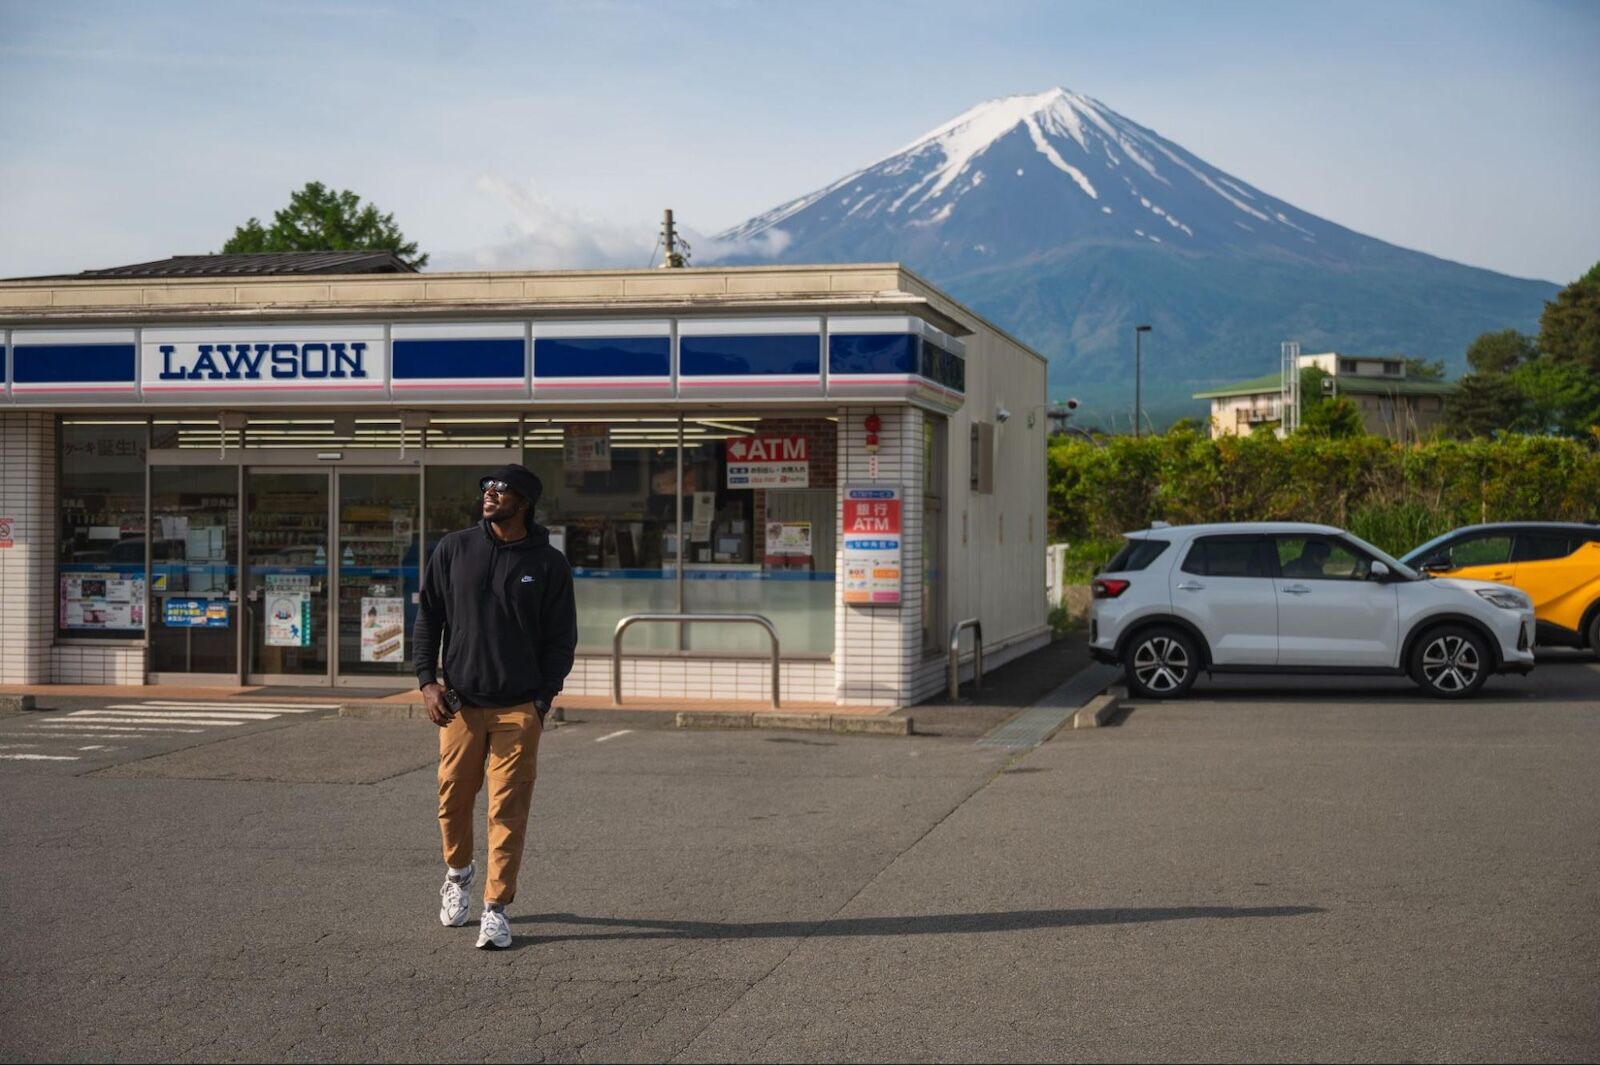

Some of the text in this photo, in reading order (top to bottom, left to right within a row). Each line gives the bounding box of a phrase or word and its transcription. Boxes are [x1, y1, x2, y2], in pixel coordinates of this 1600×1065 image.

[159, 343, 367, 380] LAWSON
[747, 438, 806, 460] ATM
[856, 503, 888, 517] 銀行
[853, 517, 889, 531] ATM
